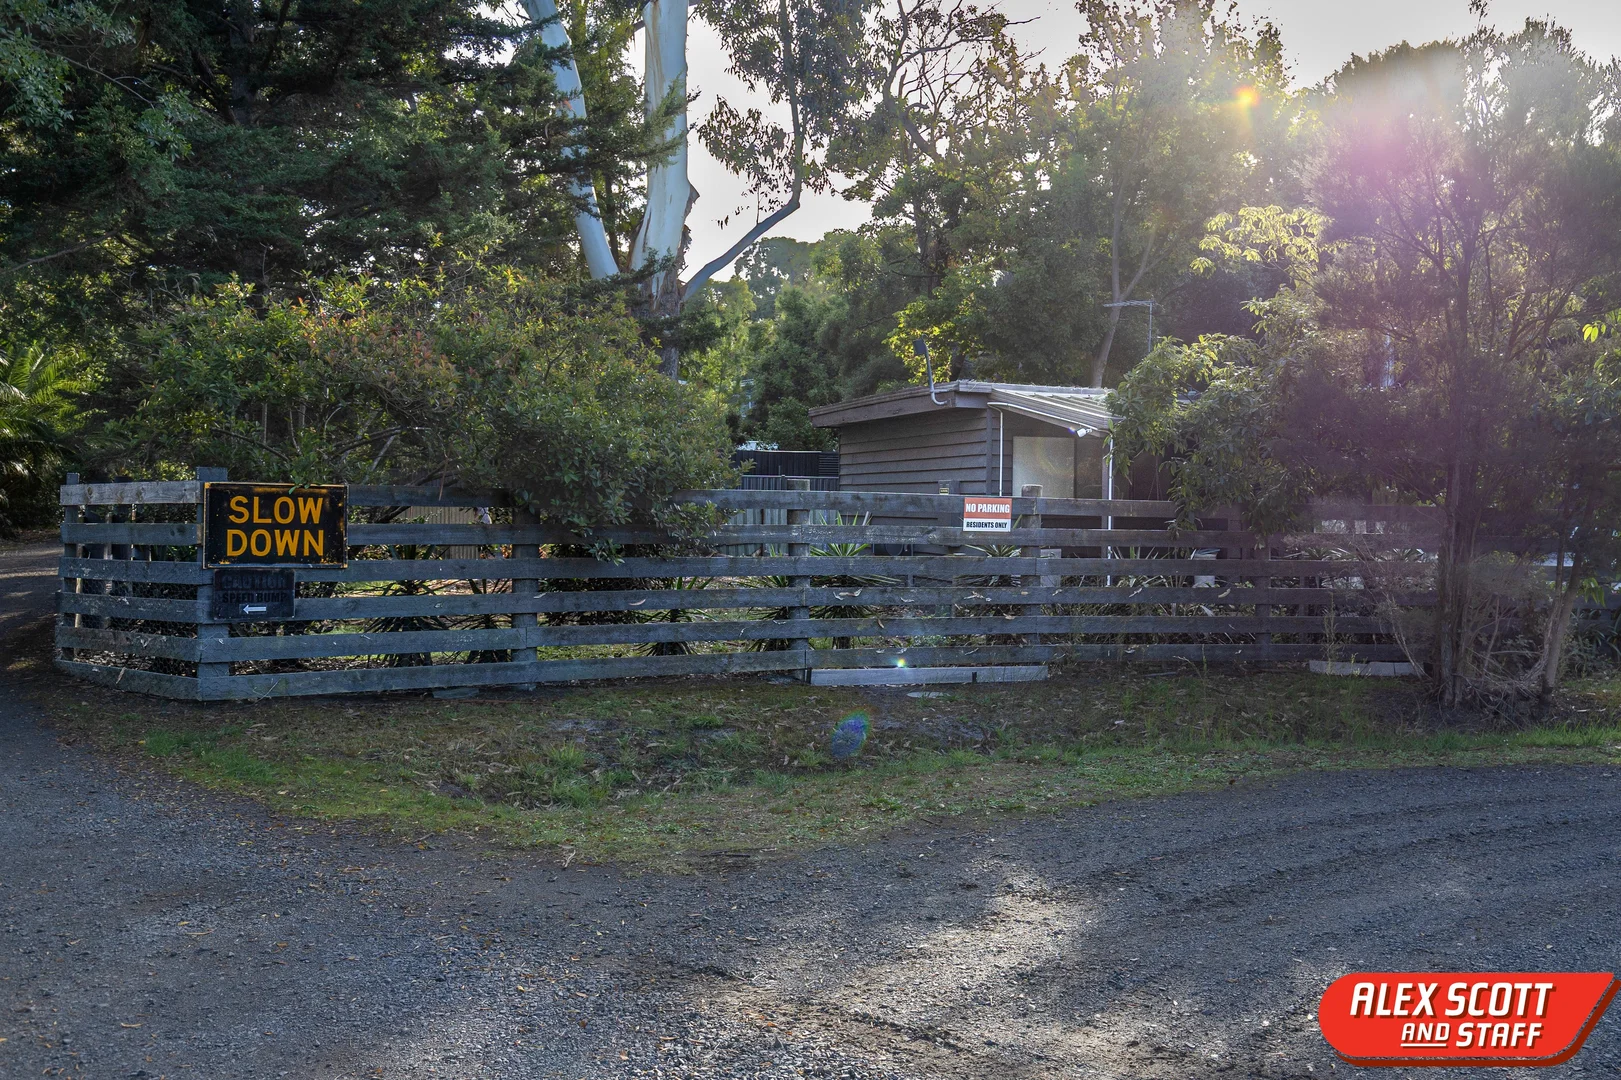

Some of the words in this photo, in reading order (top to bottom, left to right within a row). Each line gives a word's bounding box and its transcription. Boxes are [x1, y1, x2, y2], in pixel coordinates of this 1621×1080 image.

[228, 495, 324, 525] SLOW
[965, 503, 976, 513] NO
[977, 503, 1010, 514] PARKING
[966, 521, 994, 529] RESIDENTS
[995, 521, 1008, 529] ONLY
[226, 529, 324, 557] DOWN
[221, 574, 287, 589] CAUTION
[222, 591, 254, 603] SPEED
[257, 591, 287, 603] BUMP
